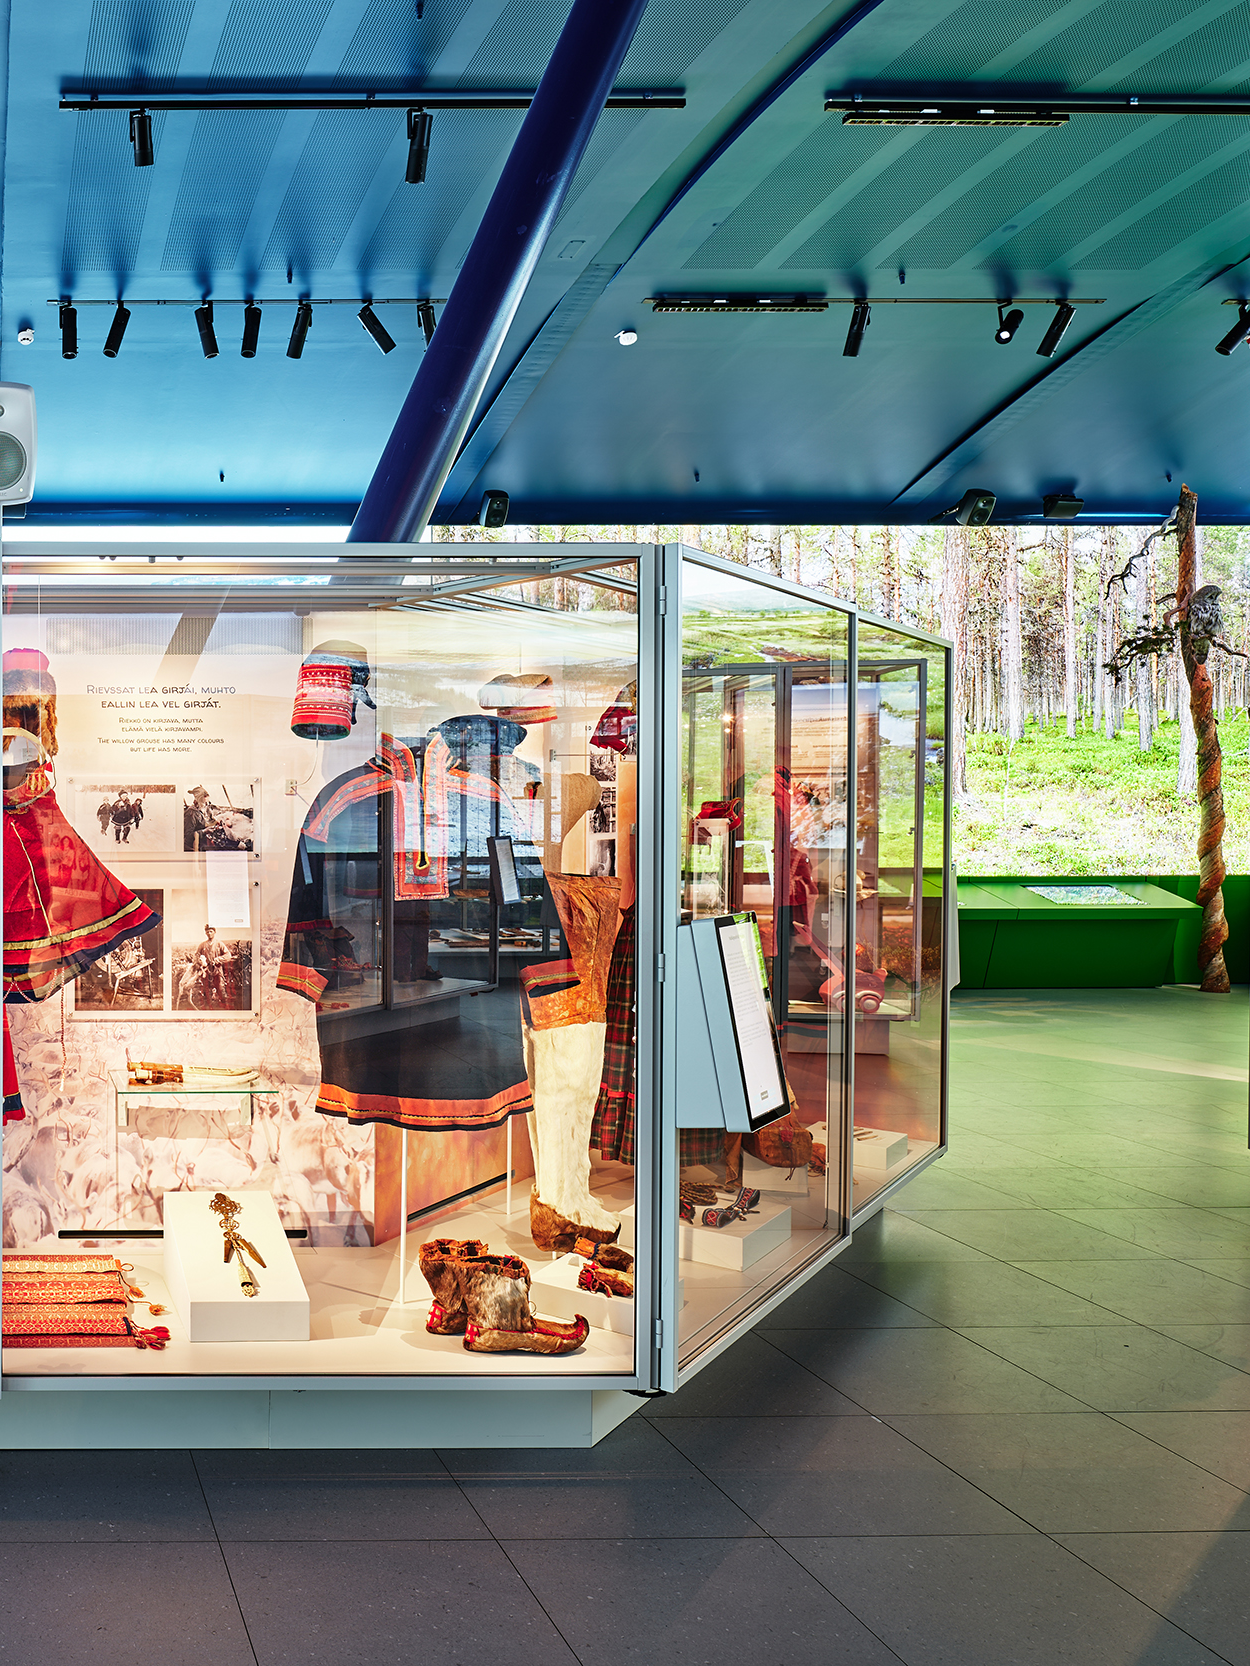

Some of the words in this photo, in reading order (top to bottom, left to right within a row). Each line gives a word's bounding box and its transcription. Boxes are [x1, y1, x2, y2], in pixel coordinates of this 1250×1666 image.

[86, 684, 135, 694] RIEVSSAT
[138, 685, 158, 694] LEA
[201, 686, 236, 694] MUHTO
[101, 700, 136, 708] EALLIN
[140, 700, 158, 708] LEA
[162, 700, 180, 708] VEL
[183, 698, 222, 708] GIRJÁT.
